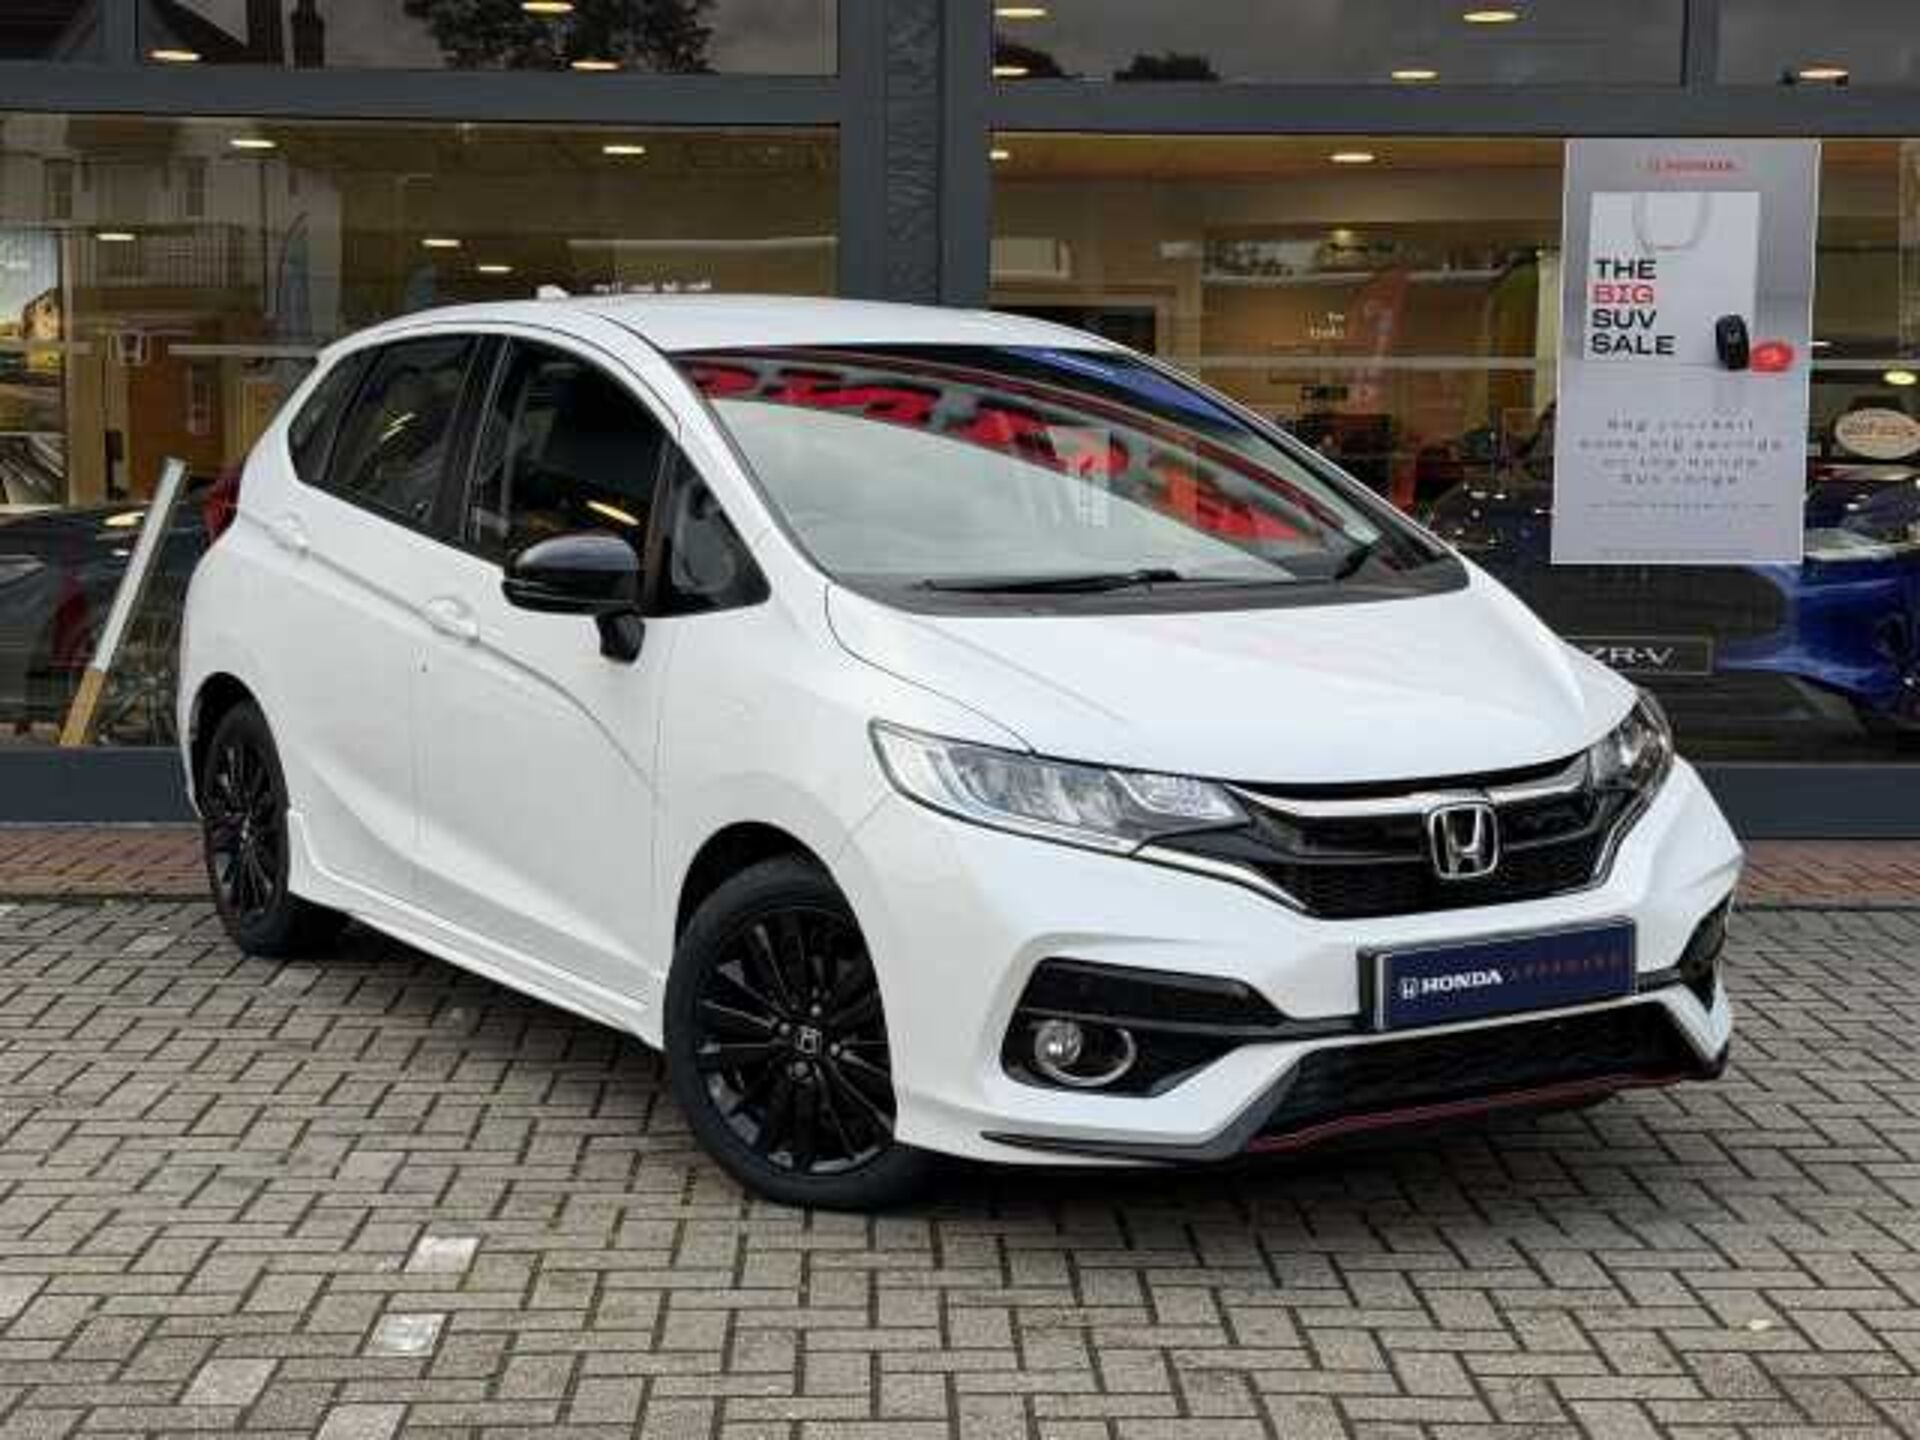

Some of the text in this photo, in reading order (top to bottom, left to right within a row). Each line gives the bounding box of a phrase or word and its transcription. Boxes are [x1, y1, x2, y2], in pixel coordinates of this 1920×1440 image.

[1594, 258, 1657, 280] THE
[1594, 284, 1654, 304] BIG
[1592, 307, 1657, 330] SUV
[1591, 333, 1676, 356] SALE
[1421, 969, 1503, 995] HONDA
